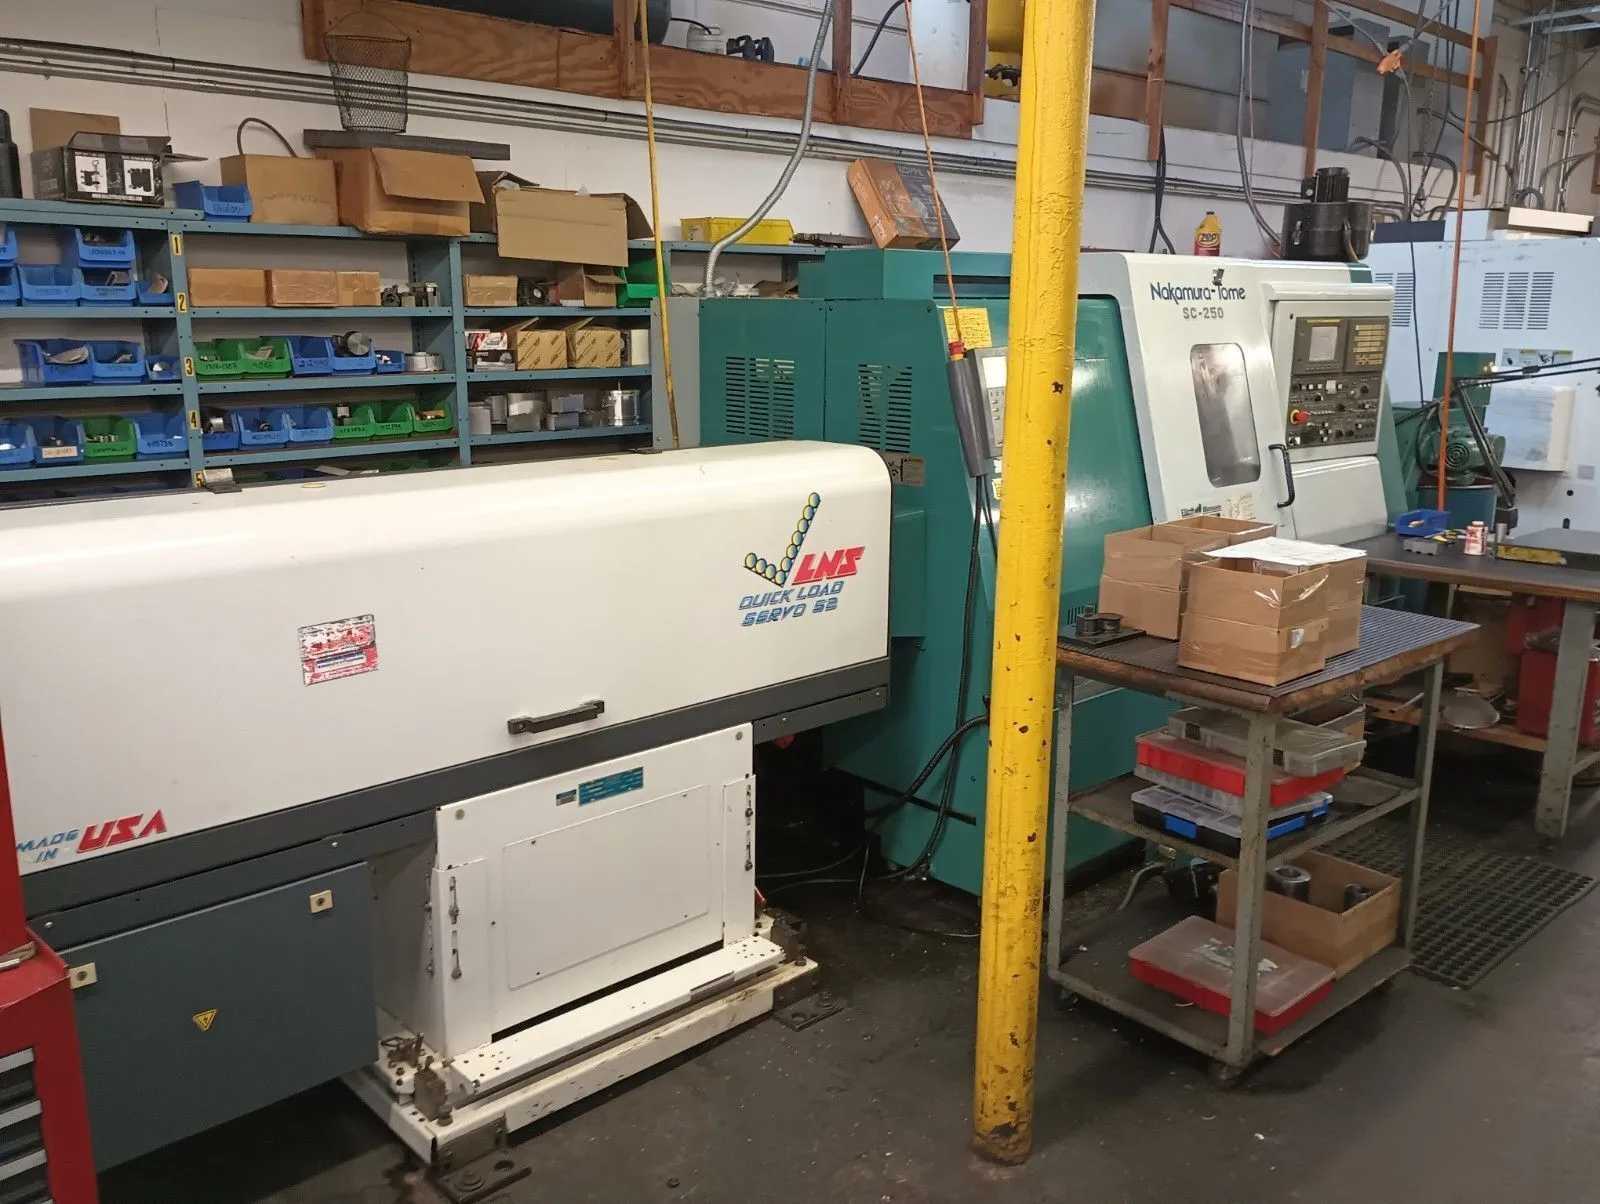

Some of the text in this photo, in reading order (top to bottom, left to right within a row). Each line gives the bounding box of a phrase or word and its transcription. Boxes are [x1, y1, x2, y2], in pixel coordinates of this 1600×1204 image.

[178, 294, 186, 312] 2
[1150, 281, 1246, 305] Nakamura-Tome
[1182, 306, 1225, 320] SC-250
[185, 358, 194, 375] 3
[190, 411, 198, 428] 4
[791, 546, 866, 586] LNS
[738, 580, 845, 611] QUICK LOAD
[740, 603, 807, 627] SERVO
[16, 828, 81, 853] MADE
[76, 808, 168, 855] USA
[35, 847, 60, 865] IN
